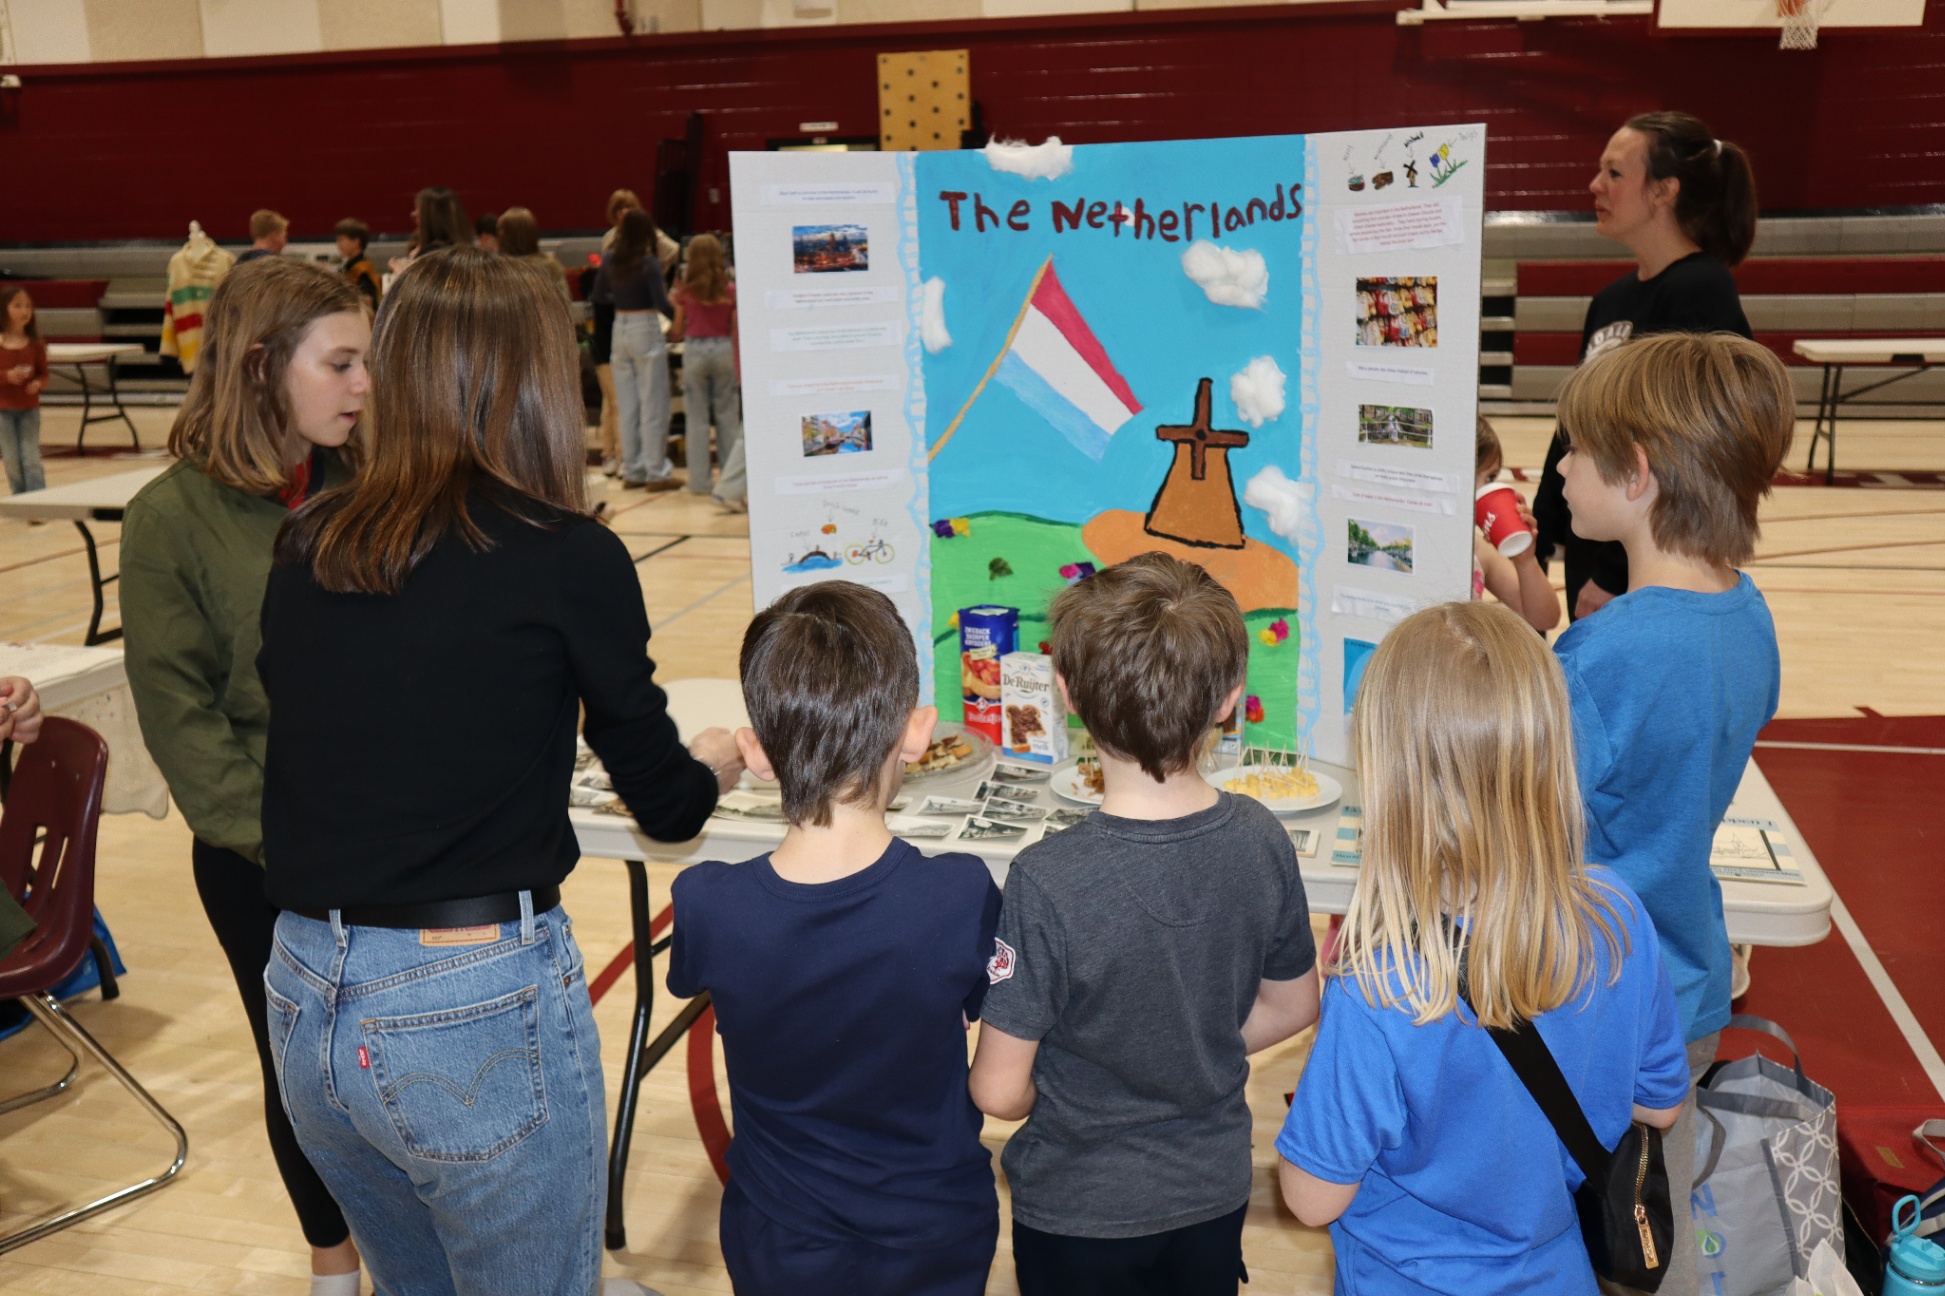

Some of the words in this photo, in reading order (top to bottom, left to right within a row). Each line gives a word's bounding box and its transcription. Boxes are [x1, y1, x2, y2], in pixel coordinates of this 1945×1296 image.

[939, 190, 1031, 233] The
[1050, 183, 1302, 243] Netherlands
[1003, 673, 1015, 687] De
[1015, 675, 1050, 692] Ruijter
